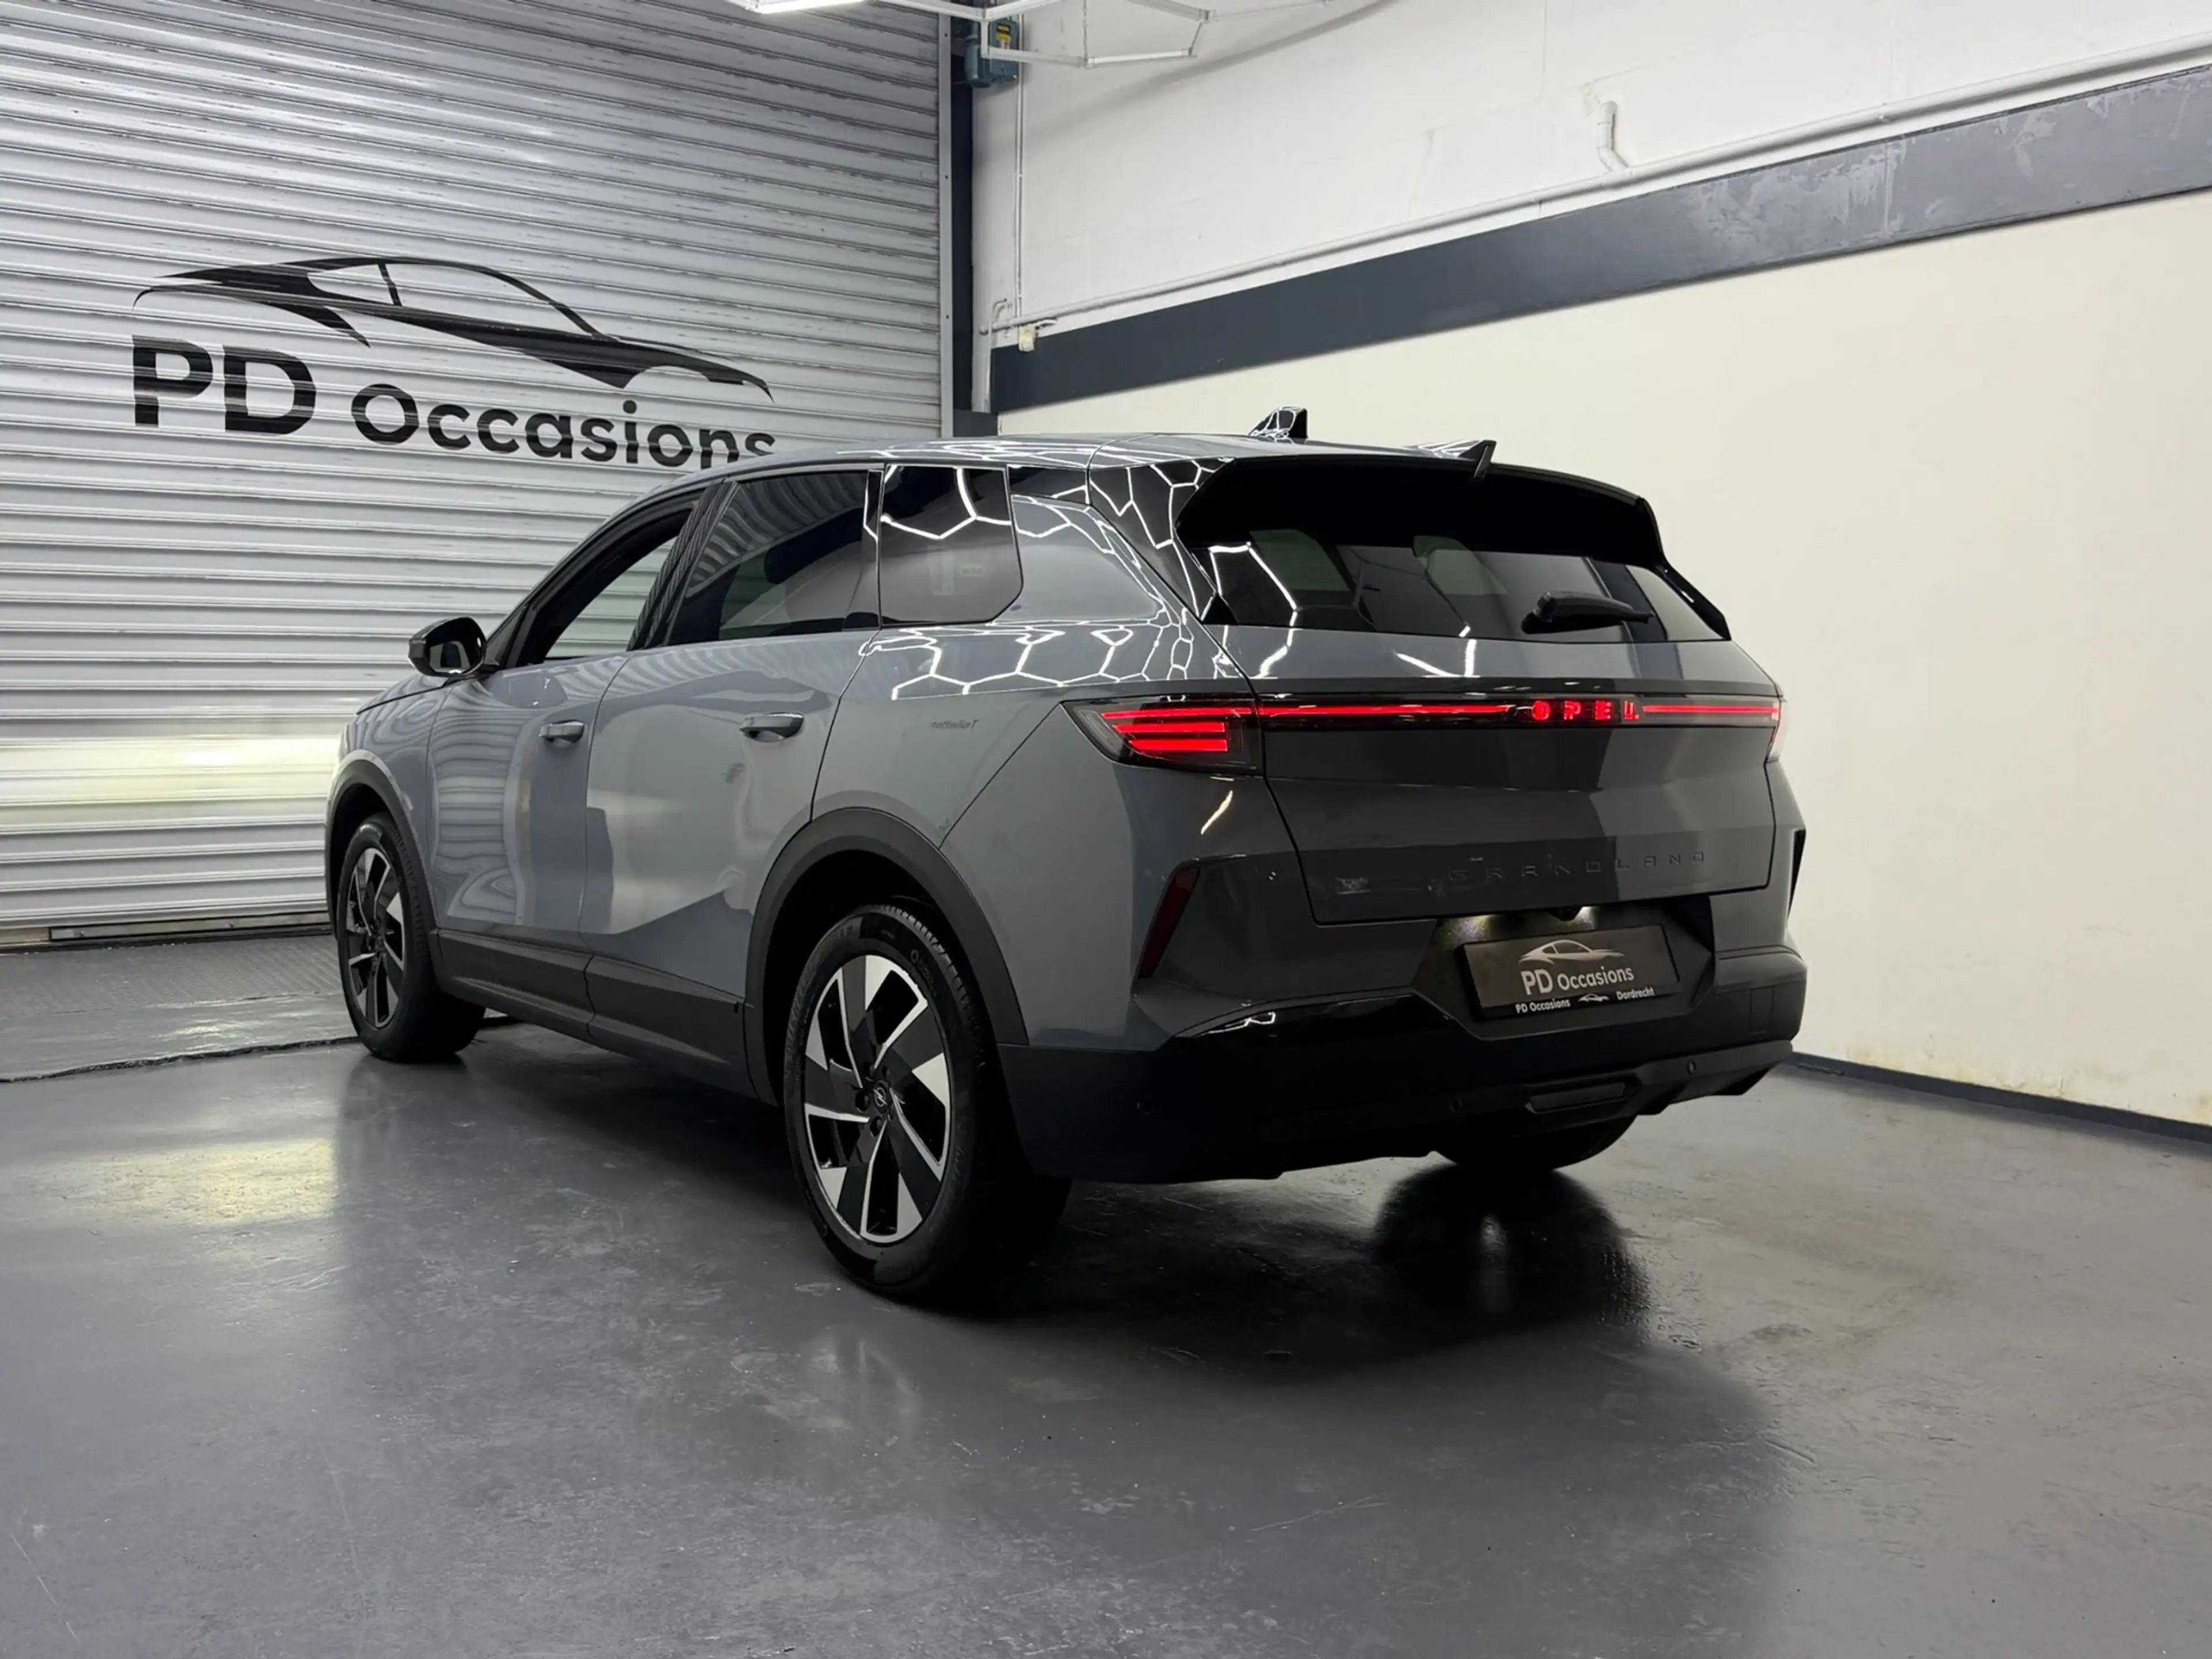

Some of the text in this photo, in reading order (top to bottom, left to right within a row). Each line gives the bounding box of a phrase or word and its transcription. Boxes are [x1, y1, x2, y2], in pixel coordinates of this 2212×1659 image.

[132, 335, 316, 435] PD
[1532, 700, 1639, 721] OPEL
[1447, 851, 1705, 881] GRANDLAND
[1521, 965, 1634, 995] PD Occasions
[1516, 987, 1654, 1014] PD Occasions Dordrecht
